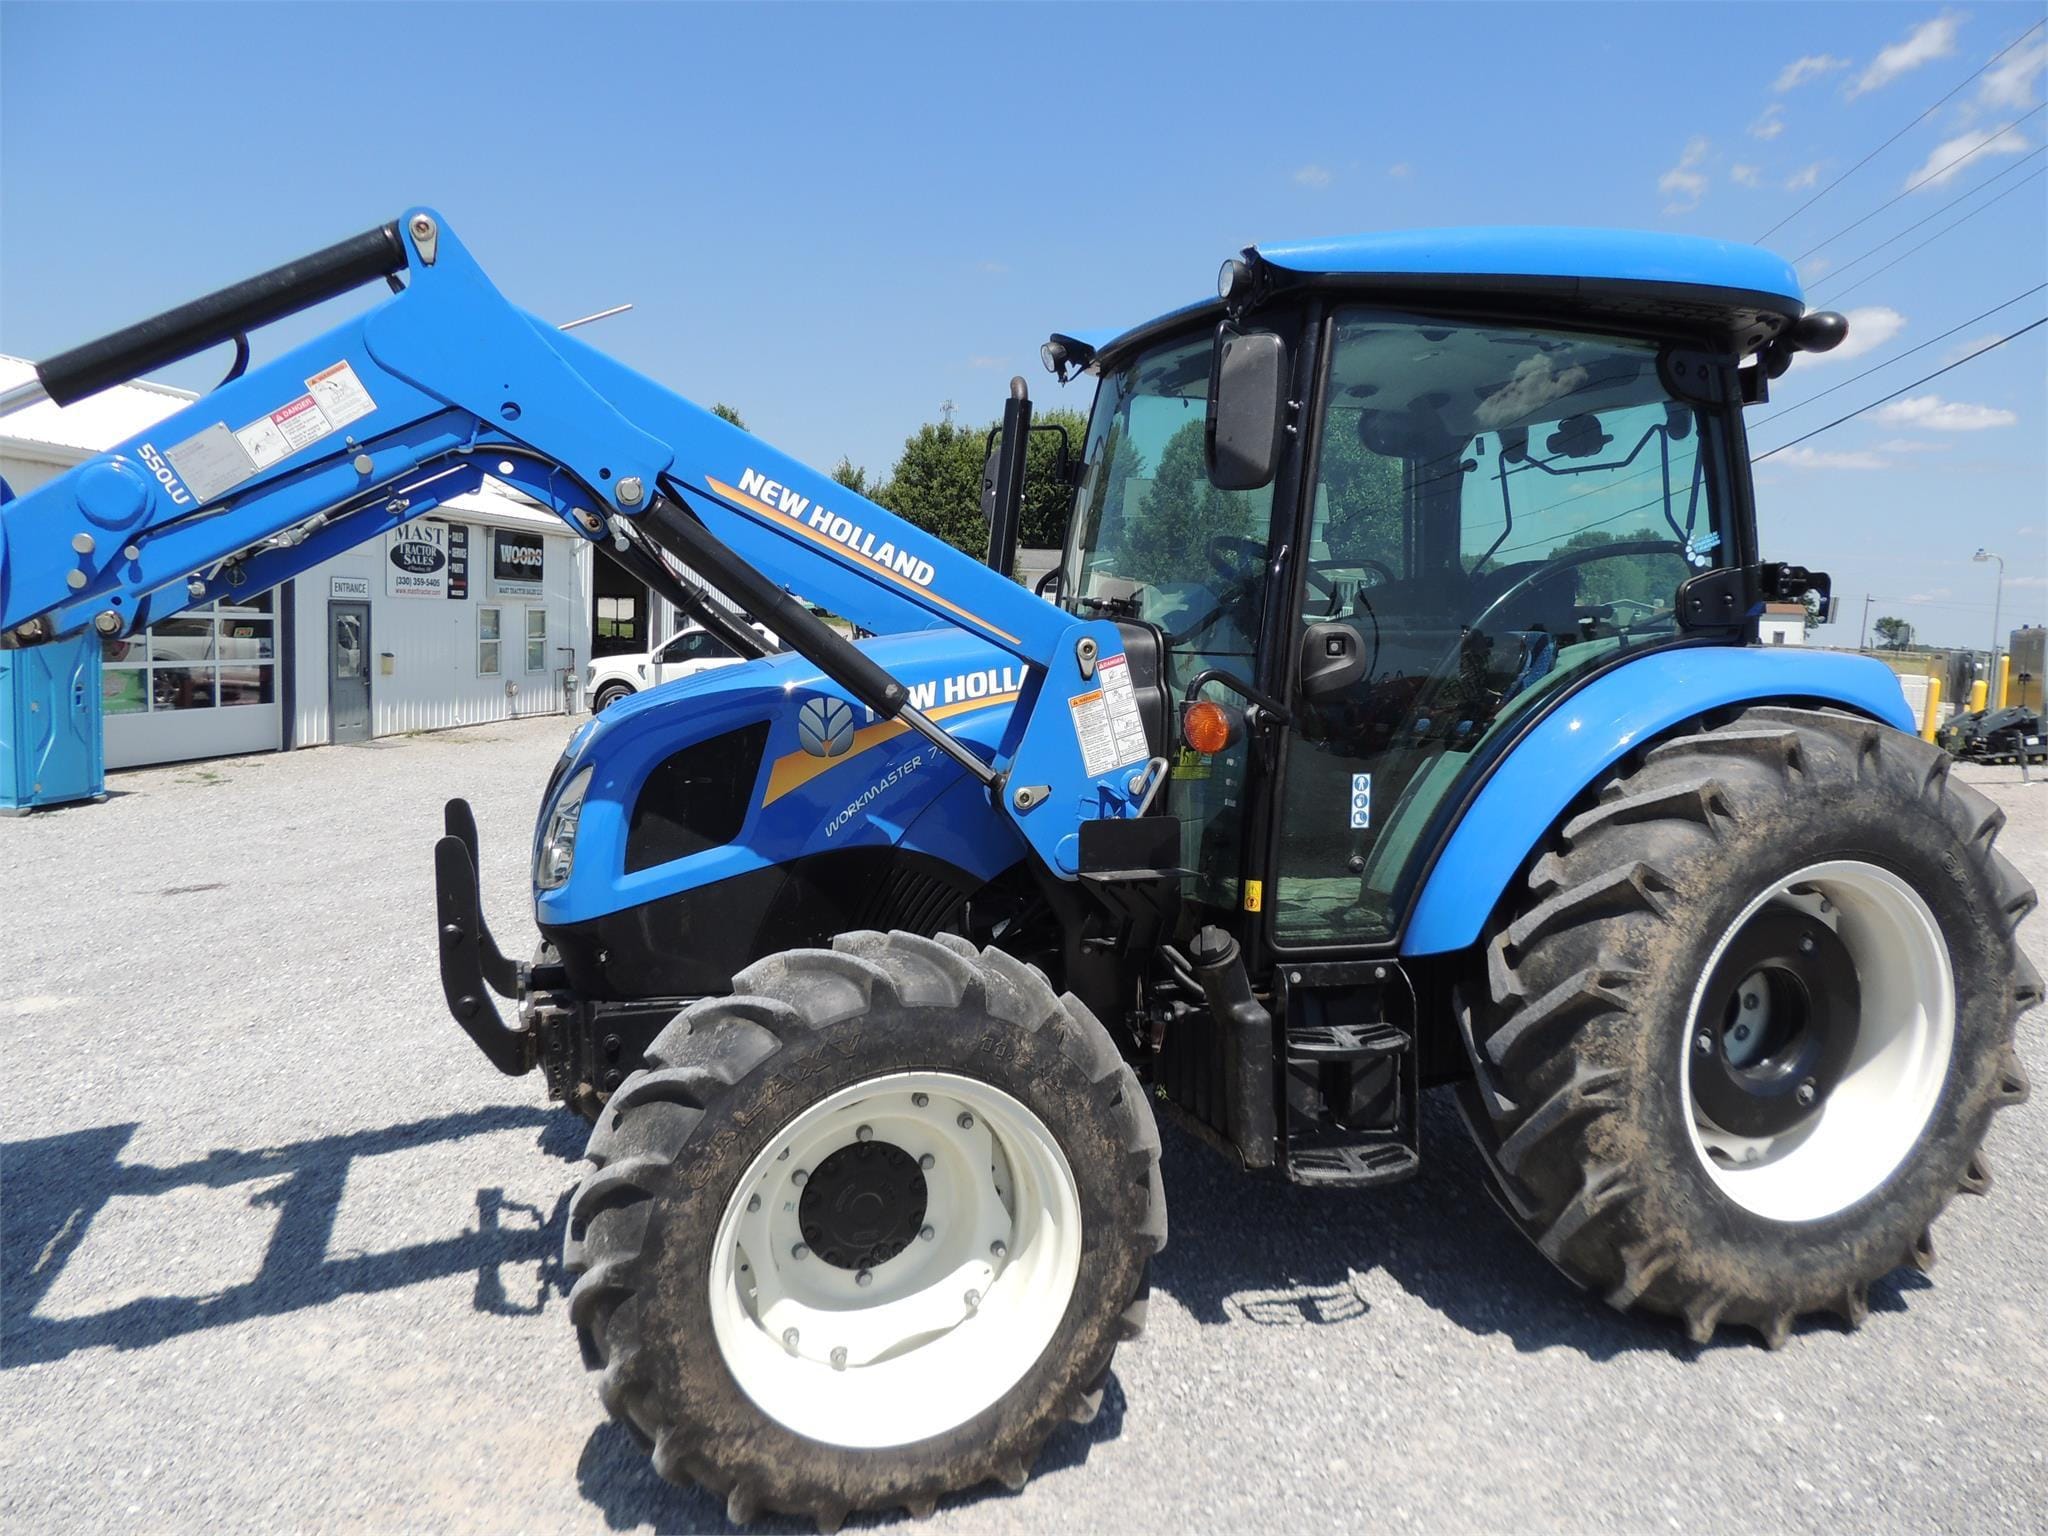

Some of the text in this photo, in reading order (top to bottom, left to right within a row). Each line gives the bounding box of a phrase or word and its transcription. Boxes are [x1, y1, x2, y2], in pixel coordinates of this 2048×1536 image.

[282, 398, 312, 417] DANGER
[136, 443, 190, 505] 550LU
[395, 524, 444, 545] MAST
[738, 467, 935, 587] NEW HOLLAND
[400, 543, 437, 557] TRACTOR
[403, 553, 434, 566] SALES
[500, 544, 542, 567] WOODS
[334, 582, 367, 594] ENTRANCE
[396, 576, 412, 587] (330)
[825, 745, 944, 838] WORKMASTER 7
